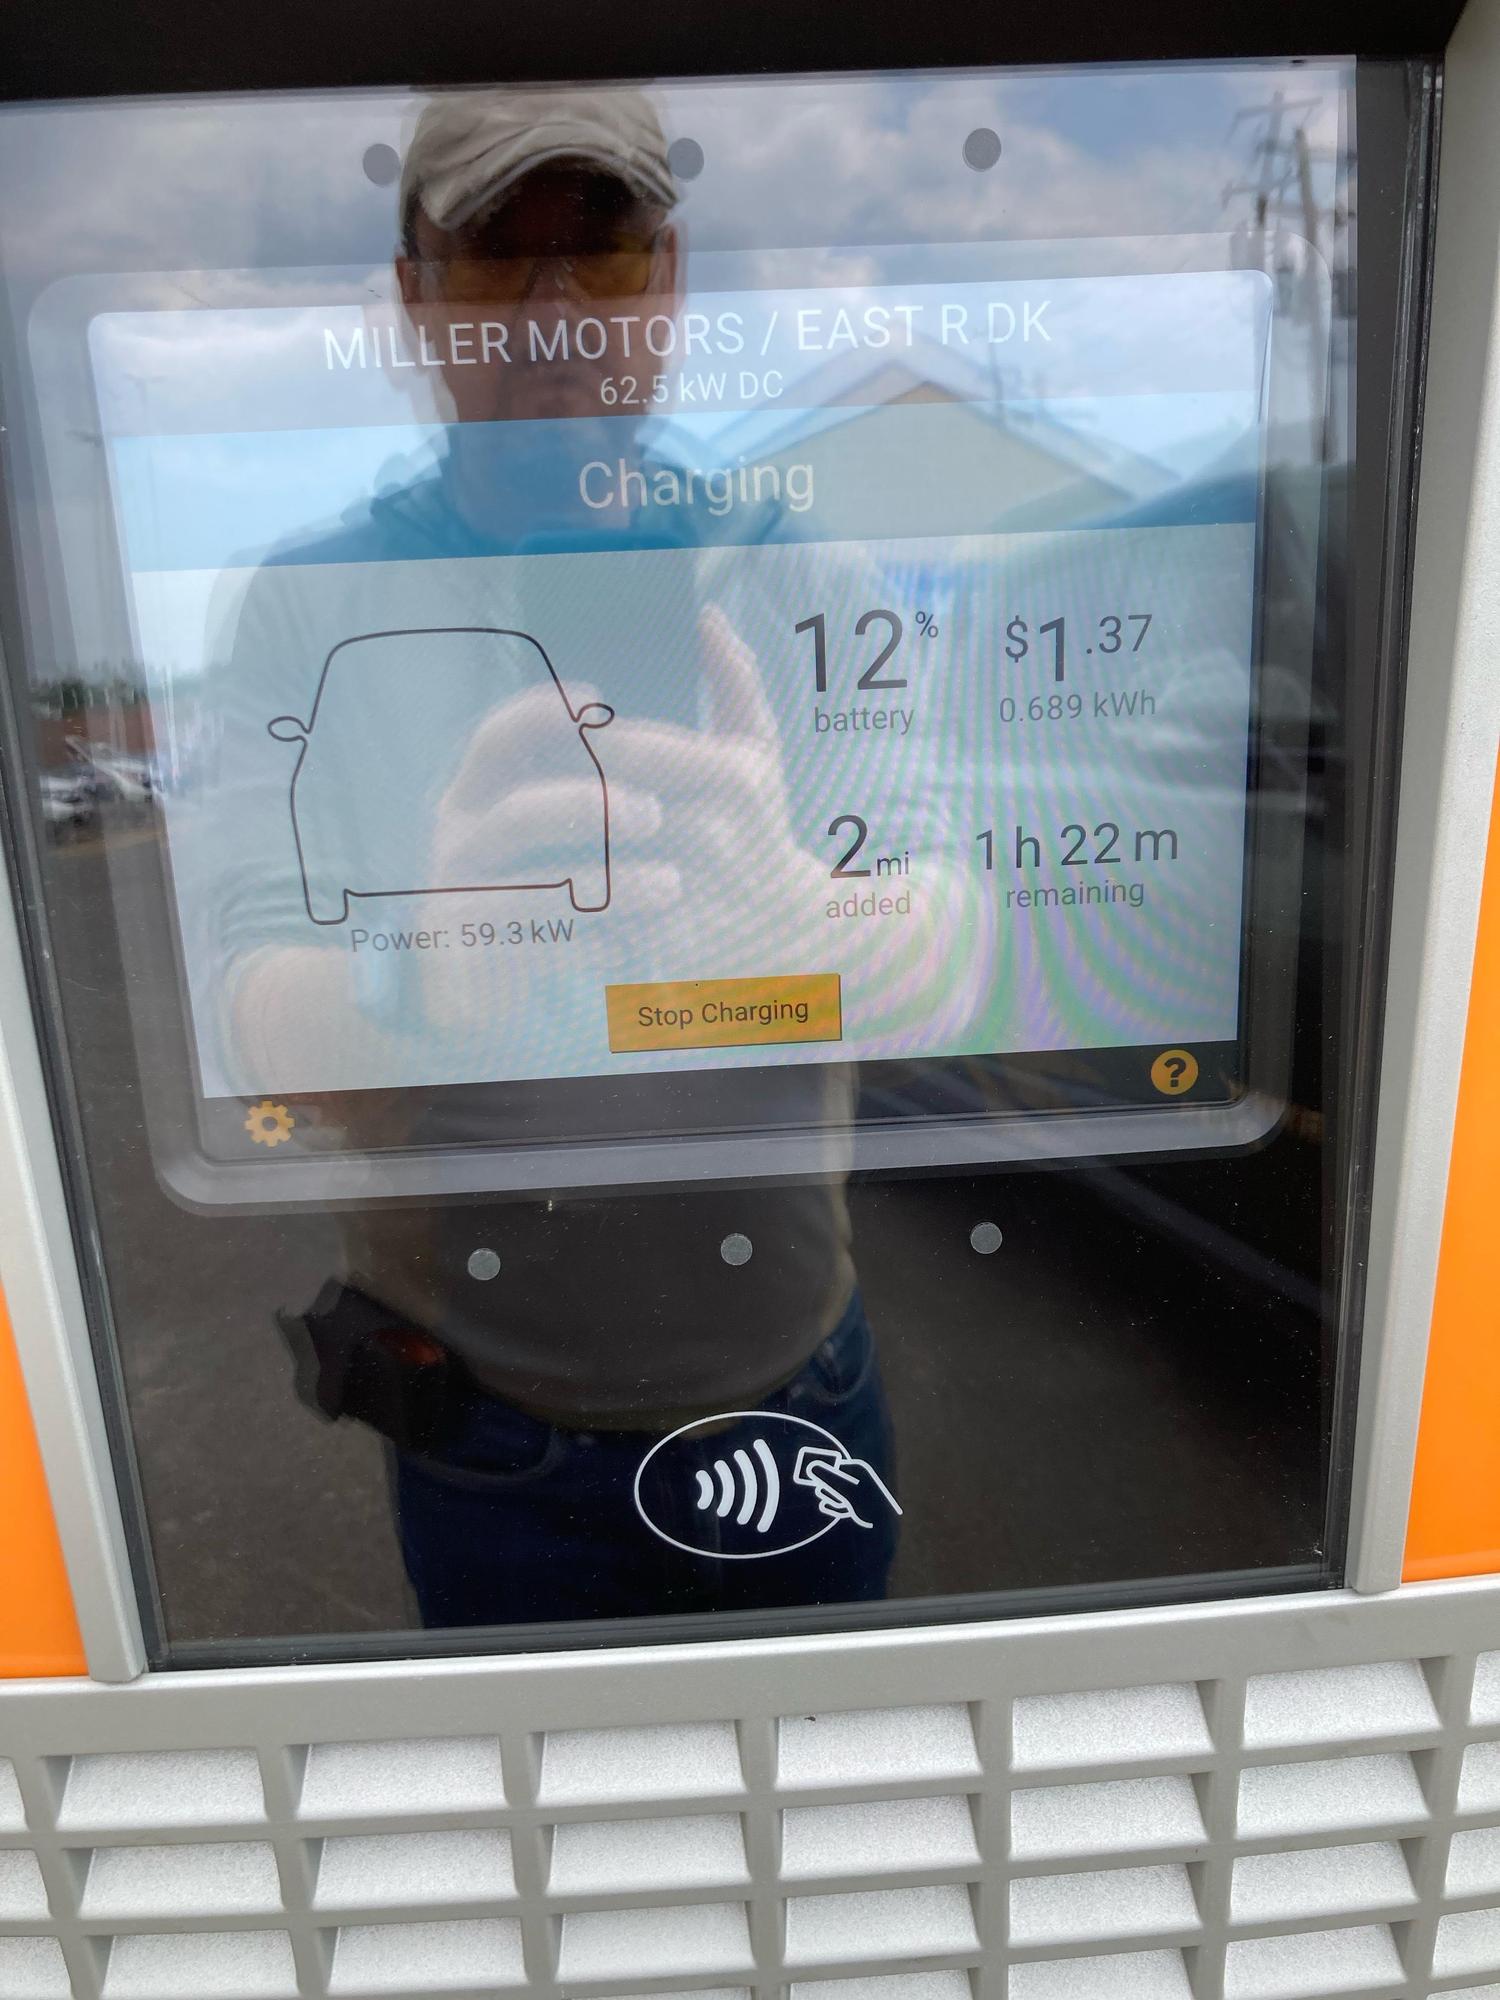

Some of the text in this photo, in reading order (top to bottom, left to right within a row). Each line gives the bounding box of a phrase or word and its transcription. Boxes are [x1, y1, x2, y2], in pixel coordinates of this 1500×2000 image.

[323, 321, 512, 371] MILLER
[528, 311, 746, 362] MOTORS
[796, 304, 924, 351] EAST
[940, 303, 969, 345] R
[987, 300, 1053, 344] DK
[600, 369, 784, 406] 62.5 kW DC
[578, 457, 815, 517] Charging
[1005, 613, 1153, 683] $1.37
[814, 706, 915, 737] battery
[999, 689, 1157, 724] 0.689 kWh
[975, 822, 1179, 871] 1 h 22 m
[826, 890, 911, 919] added
[1006, 880, 1145, 910] remaining
[351, 918, 576, 954] Power: 59.3 kW
[637, 1000, 810, 1030] Stop Charging
